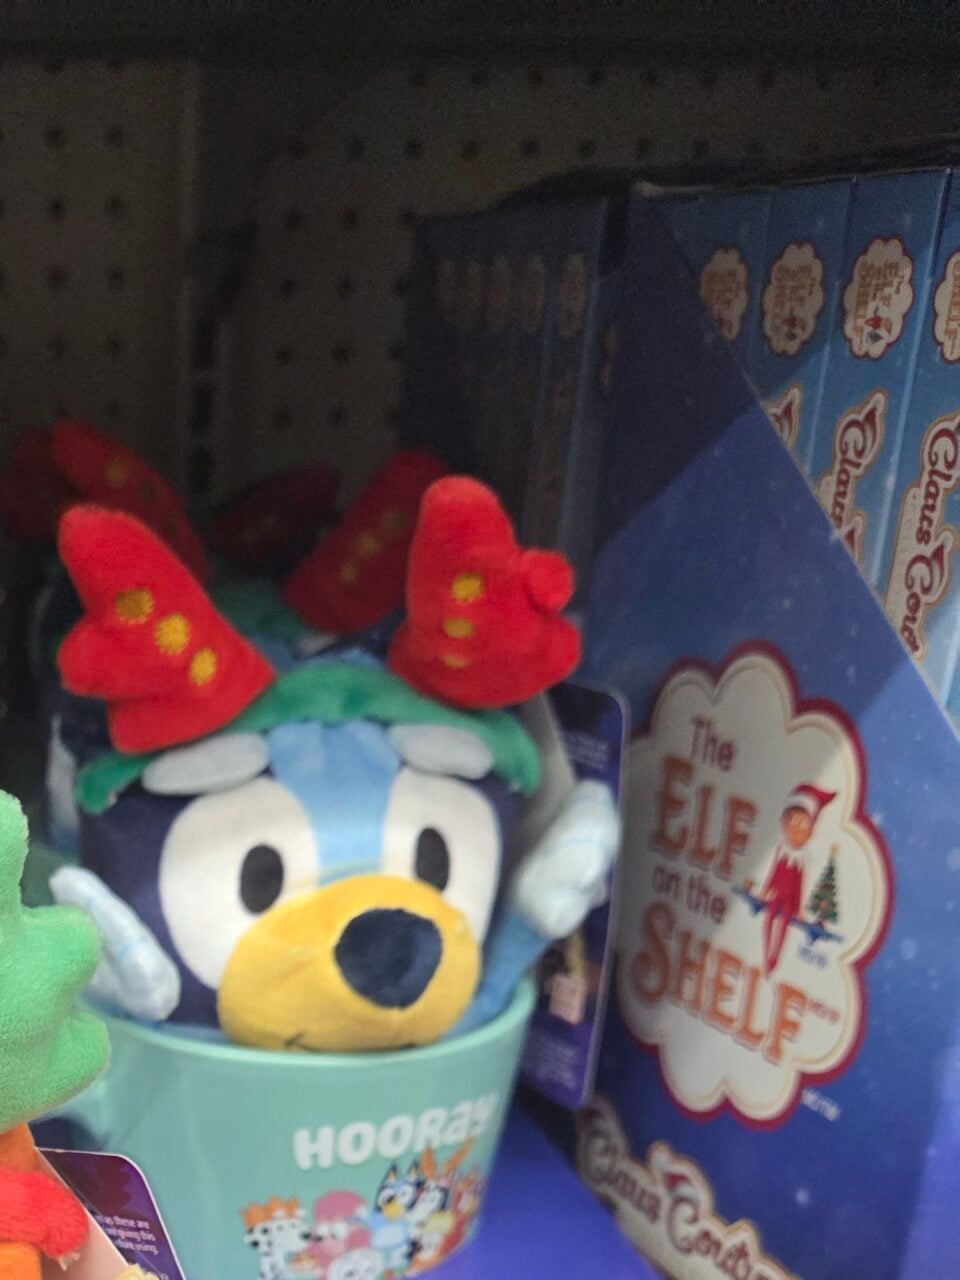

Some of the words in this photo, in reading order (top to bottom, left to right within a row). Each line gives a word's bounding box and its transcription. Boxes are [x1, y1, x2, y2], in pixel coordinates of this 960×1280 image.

[691, 715, 735, 772] The
[654, 754, 759, 880] ELF
[687, 873, 727, 924] the
[633, 900, 809, 1066] SHELF
